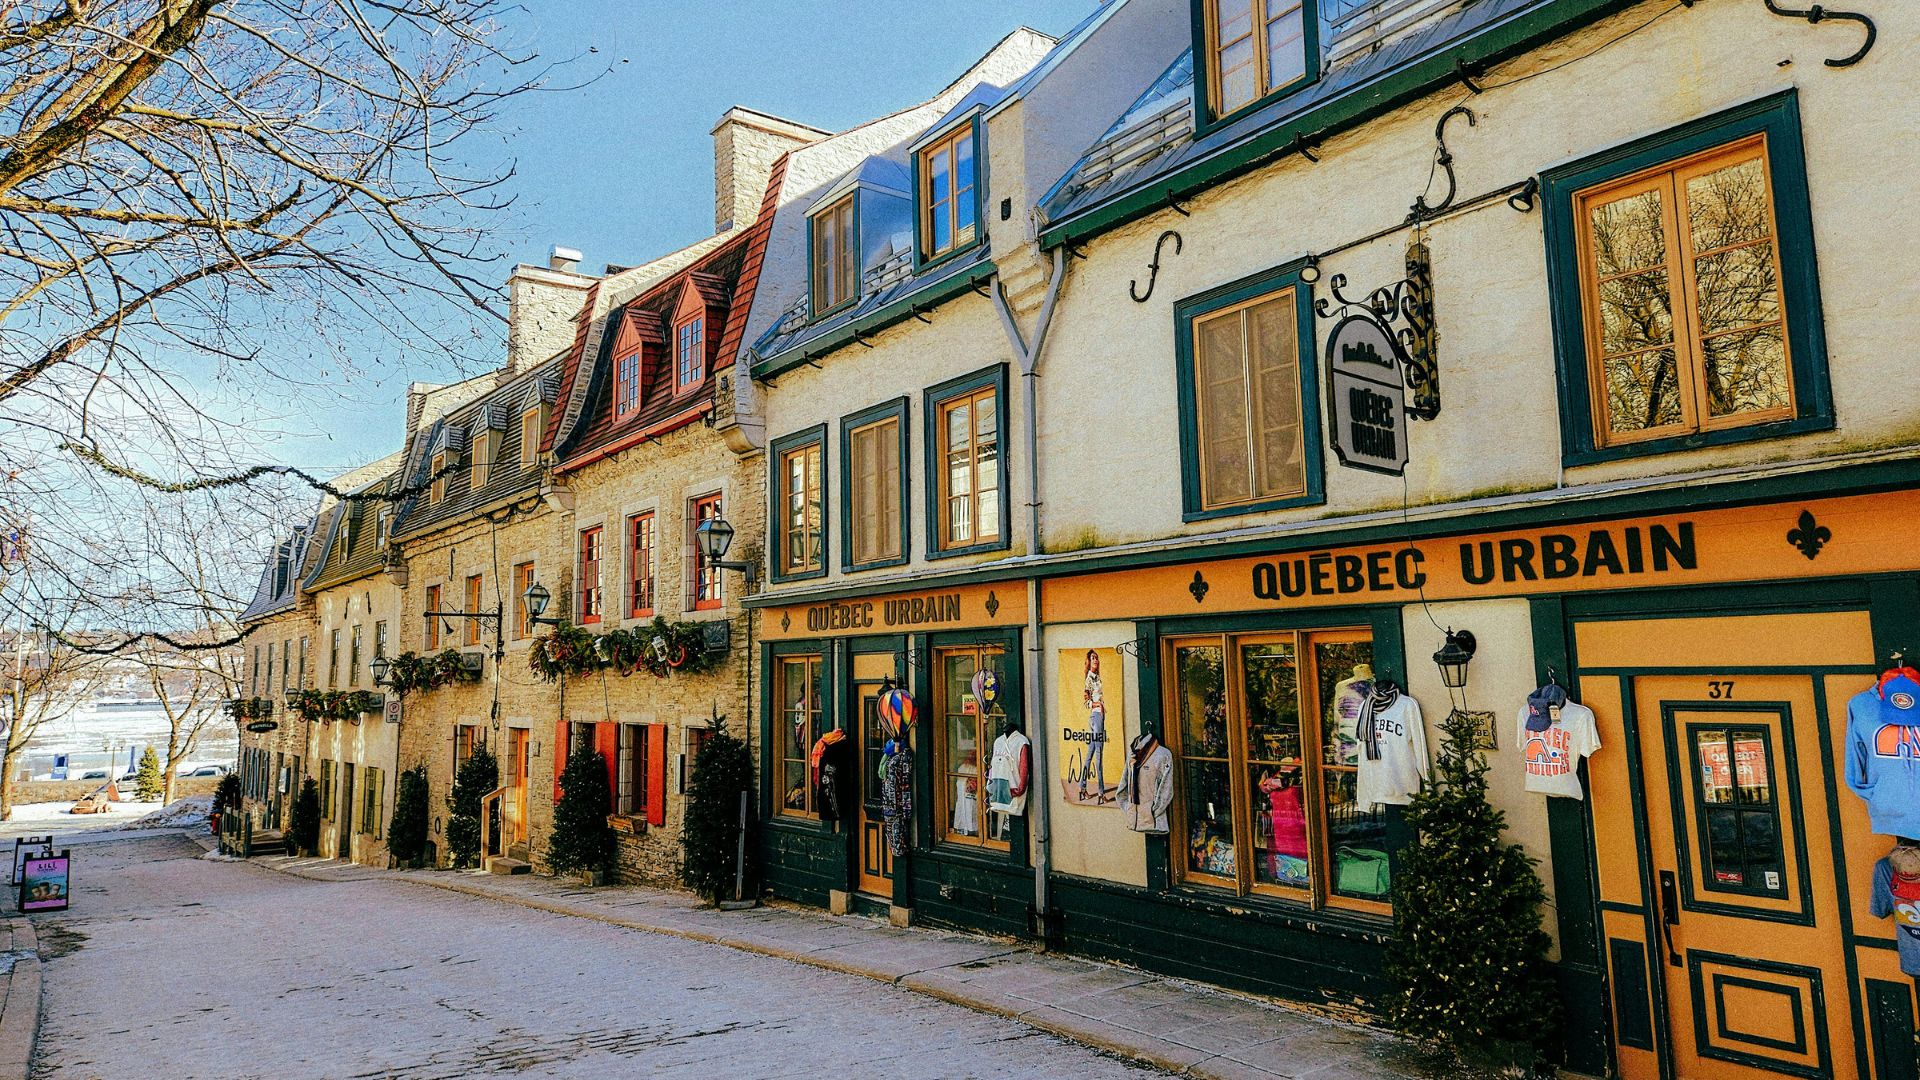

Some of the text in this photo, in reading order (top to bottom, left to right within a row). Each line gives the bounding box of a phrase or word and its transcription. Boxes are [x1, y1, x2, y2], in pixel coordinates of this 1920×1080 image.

[1351, 421, 1397, 460] URBAIN
[1459, 521, 1697, 585] URBAIN
[884, 593, 961, 626] URBAIN
[1708, 681, 1735, 699] 37
[1063, 728, 1107, 744] Desigual
[1067, 747, 1097, 784] Wow
[1711, 751, 1758, 763] OUERT
[1720, 765, 1753, 776] OEN
